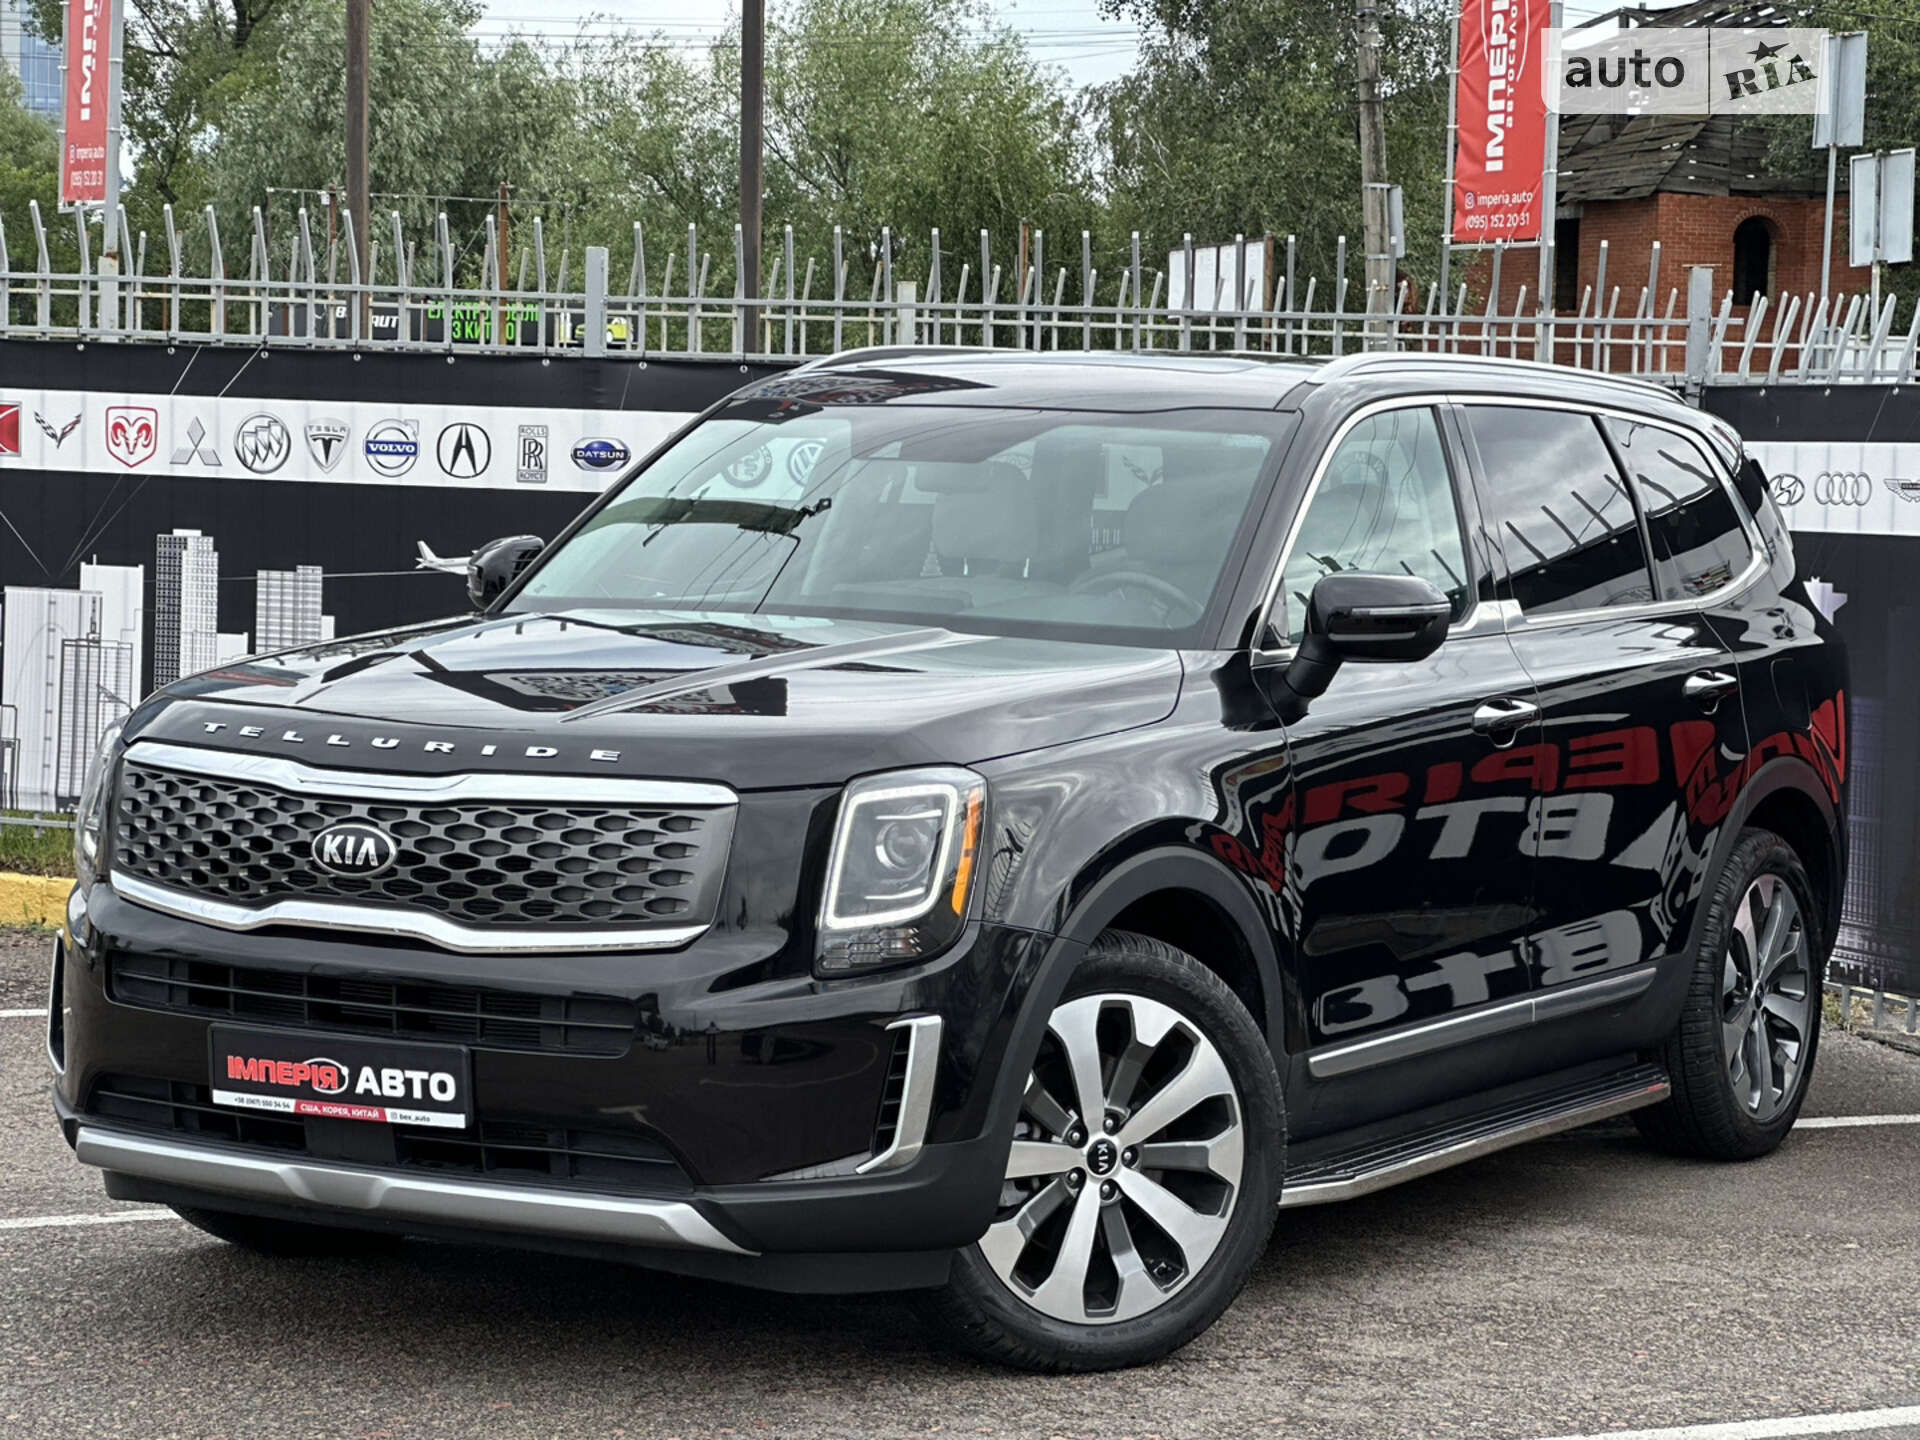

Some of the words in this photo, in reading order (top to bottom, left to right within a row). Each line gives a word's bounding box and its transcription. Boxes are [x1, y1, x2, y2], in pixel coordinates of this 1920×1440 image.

[1477, 190, 1533, 207] imperia_auto
[1465, 215, 1488, 231] (095)
[1490, 214, 1504, 228] 152
[1506, 213, 1518, 227] 20
[1520, 212, 1530, 226] 31
[308, 424, 346, 433] TESLA
[368, 442, 416, 454] VOLVO
[576, 449, 625, 459] DATSUN
[203, 721, 622, 763] TELLURIDE
[323, 834, 379, 867] KIA
[227, 1055, 339, 1090] ІМПЕРІЯ
[355, 1066, 456, 1102] АВТО
[300, 1103, 321, 1114] США,
[322, 1105, 351, 1117] КОРЕЯ,
[352, 1107, 379, 1119] КИТАЙ
[1096, 1143, 1109, 1173] KIA
